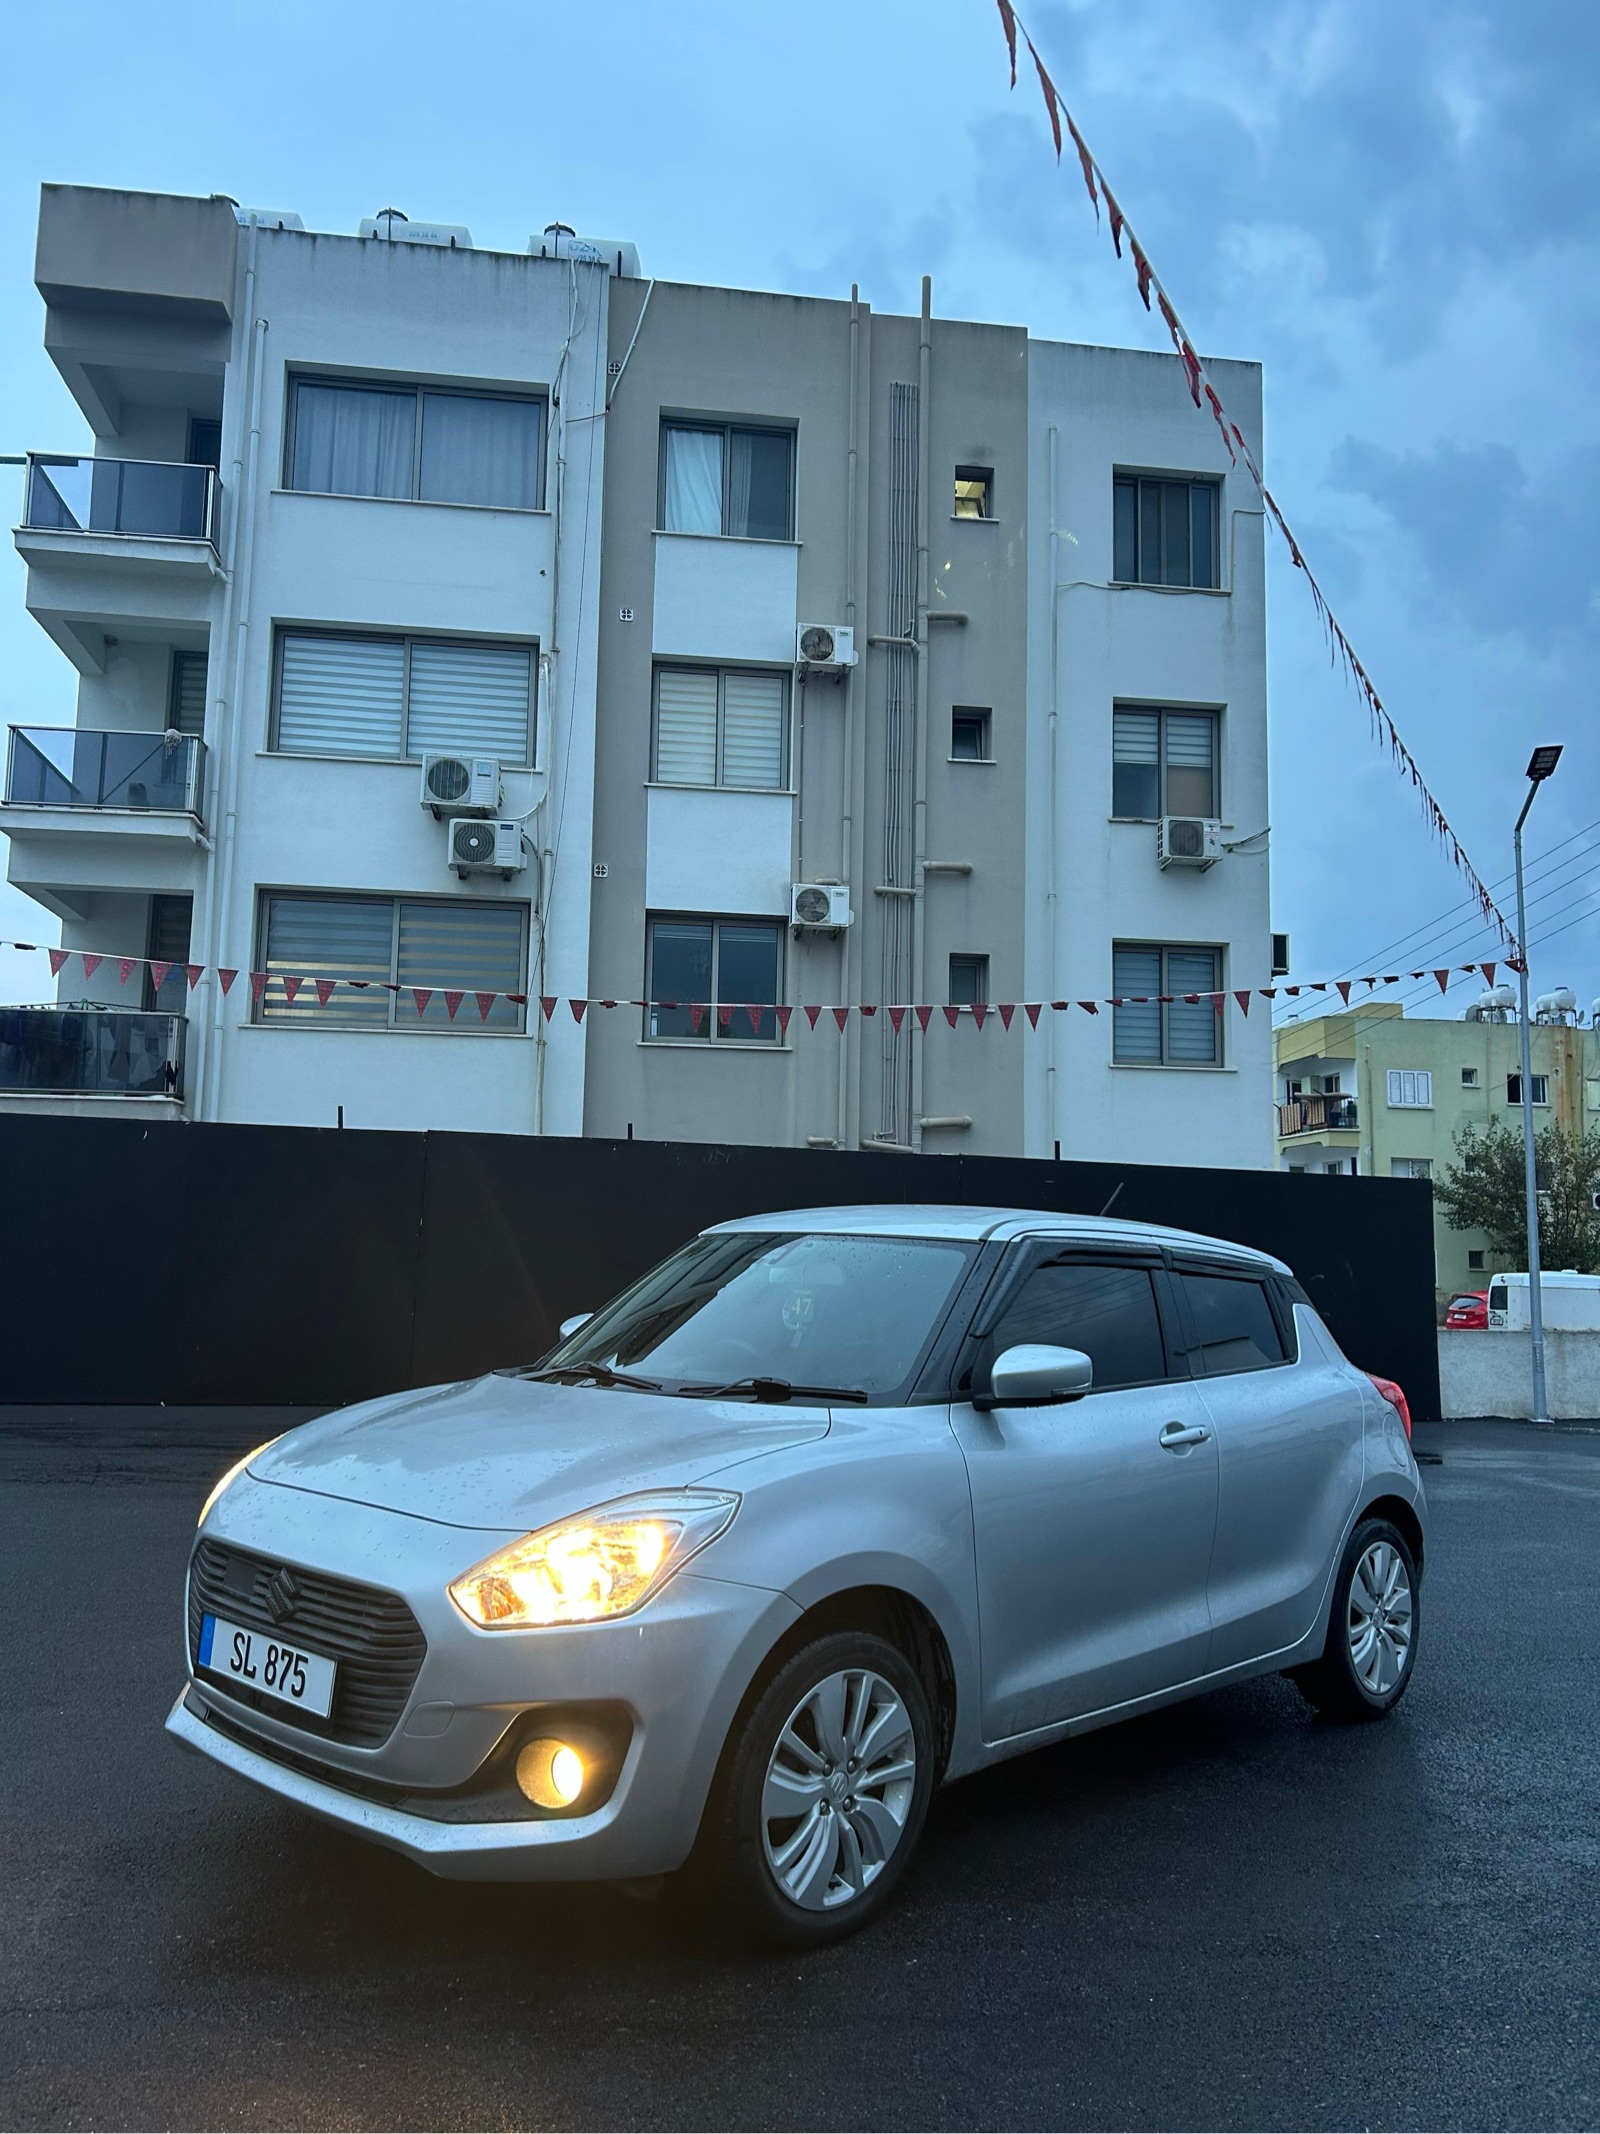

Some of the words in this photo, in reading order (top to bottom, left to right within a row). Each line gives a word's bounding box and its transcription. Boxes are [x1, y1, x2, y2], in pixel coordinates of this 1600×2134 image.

[791, 1297, 812, 1316] 47
[230, 1631, 257, 1679] SL
[264, 1644, 309, 1698] 875
